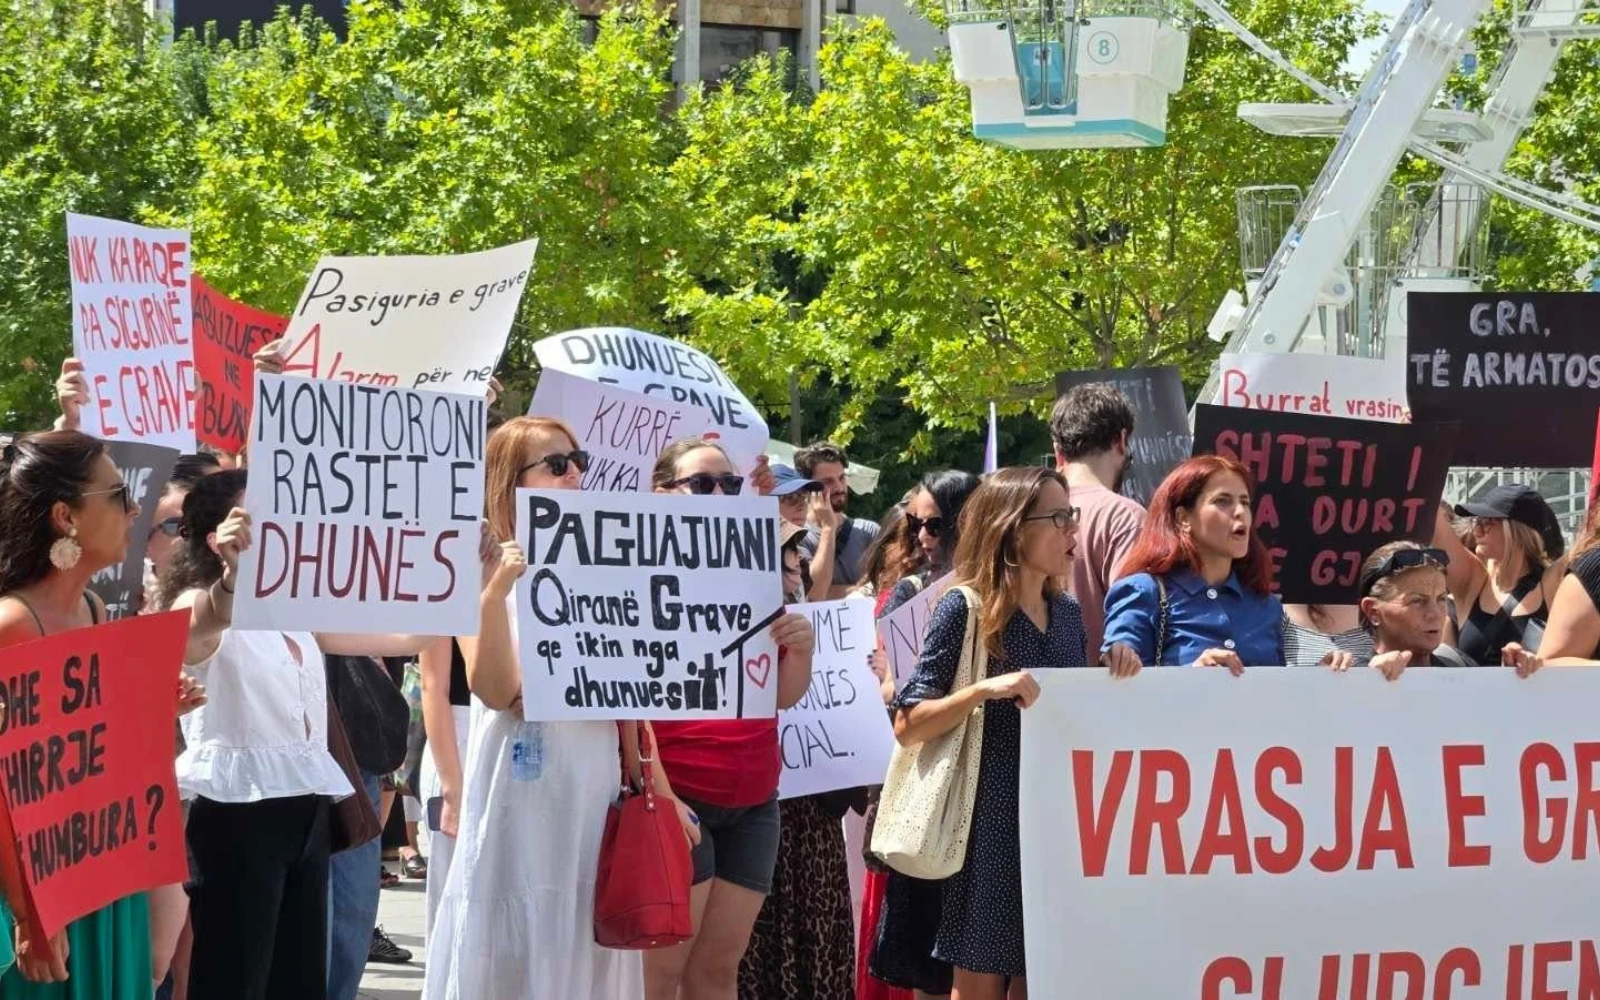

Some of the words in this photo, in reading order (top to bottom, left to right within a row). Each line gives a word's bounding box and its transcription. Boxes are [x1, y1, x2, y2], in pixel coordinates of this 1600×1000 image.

[1099, 39, 1110, 56] 8
[70, 236, 102, 284] NUK
[108, 237, 134, 284] KA
[132, 237, 187, 288] PAQE
[80, 303, 107, 351] PA
[299, 267, 441, 327] Pasiguria
[448, 288, 465, 304] e
[469, 270, 527, 311] grave
[1470, 300, 1550, 338] GRA,
[283, 323, 399, 388] Alarm
[413, 365, 453, 389] për
[1410, 348, 1450, 387] TË
[1462, 351, 1600, 390] ARMATOS
[94, 374, 119, 437] E
[119, 360, 196, 437] GRAVE
[258, 379, 483, 460] MONITORONI
[1223, 368, 1333, 414] Burrat
[585, 395, 681, 458] KURRË
[273, 448, 429, 520] RASTET
[450, 461, 478, 521] E
[581, 455, 615, 491] UK
[1214, 429, 1377, 488] SHTETI
[1407, 445, 1423, 492] I
[527, 495, 776, 572] PAGUAJUANI
[1254, 493, 1281, 530] A
[1312, 495, 1425, 535] DURT
[254, 519, 459, 602] DHUNËS
[1310, 549, 1362, 587] GJ
[530, 567, 640, 627] Qiranë
[650, 574, 752, 634] Grave
[62, 653, 102, 714] SA
[536, 639, 562, 676] qe
[575, 632, 625, 658] ikin
[632, 639, 680, 679] nga
[564, 652, 728, 711] dhunuesit!
[0, 722, 107, 811] HIRRJE
[780, 720, 857, 769] CIAL.
[1071, 745, 1416, 878] VRASJA
[1441, 744, 1492, 868] E
